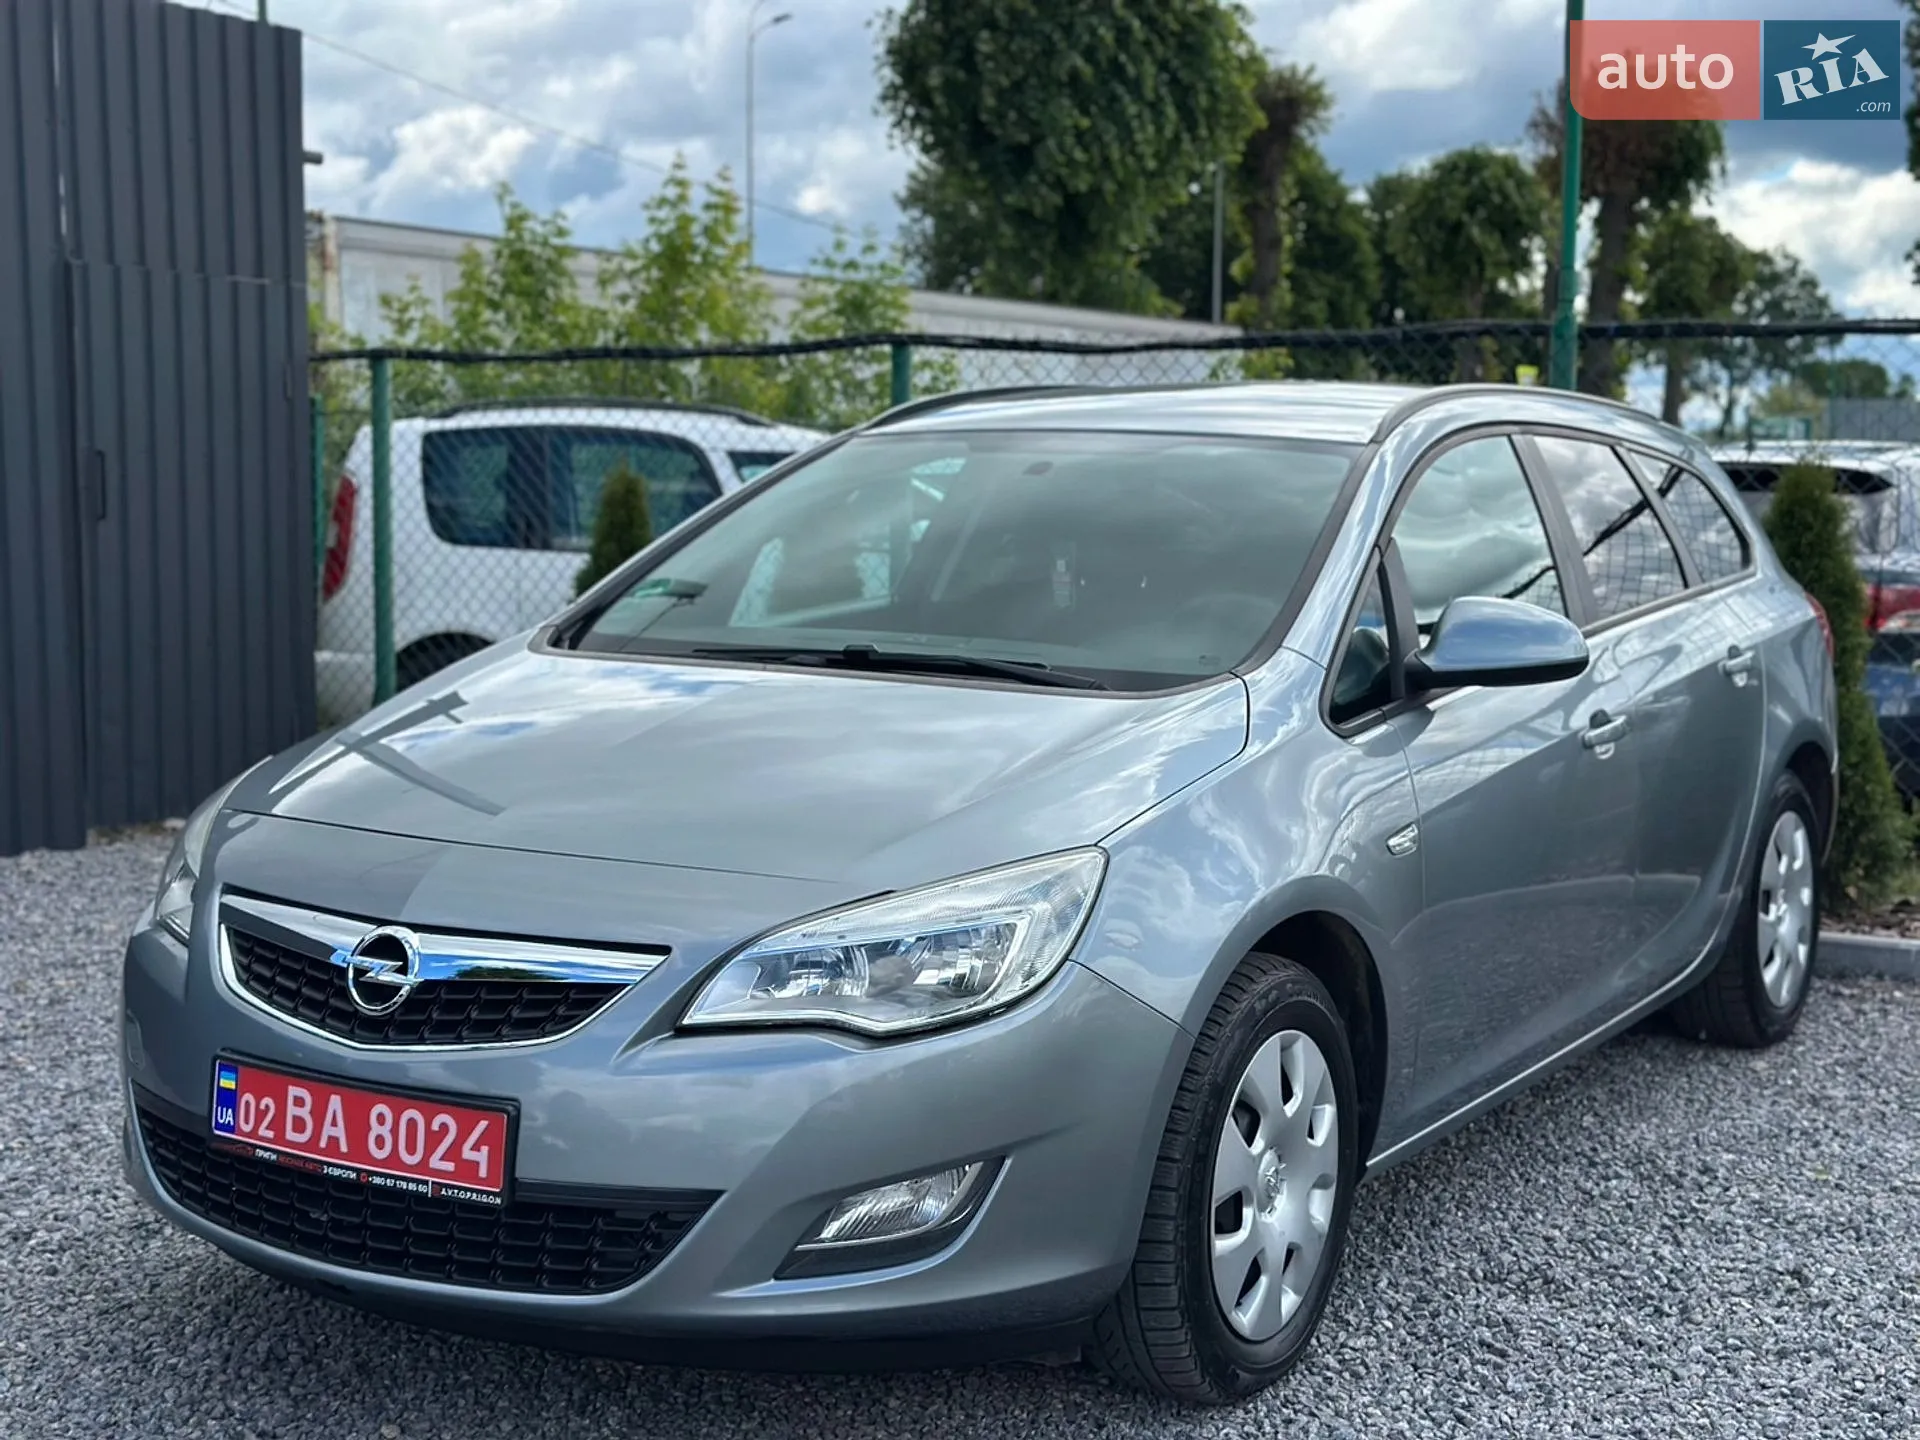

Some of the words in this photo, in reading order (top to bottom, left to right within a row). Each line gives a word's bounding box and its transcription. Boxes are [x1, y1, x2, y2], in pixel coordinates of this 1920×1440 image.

[216, 1105, 235, 1127] UA
[238, 1092, 276, 1140] 02
[284, 1085, 349, 1154] BA
[367, 1103, 490, 1179] 8024
